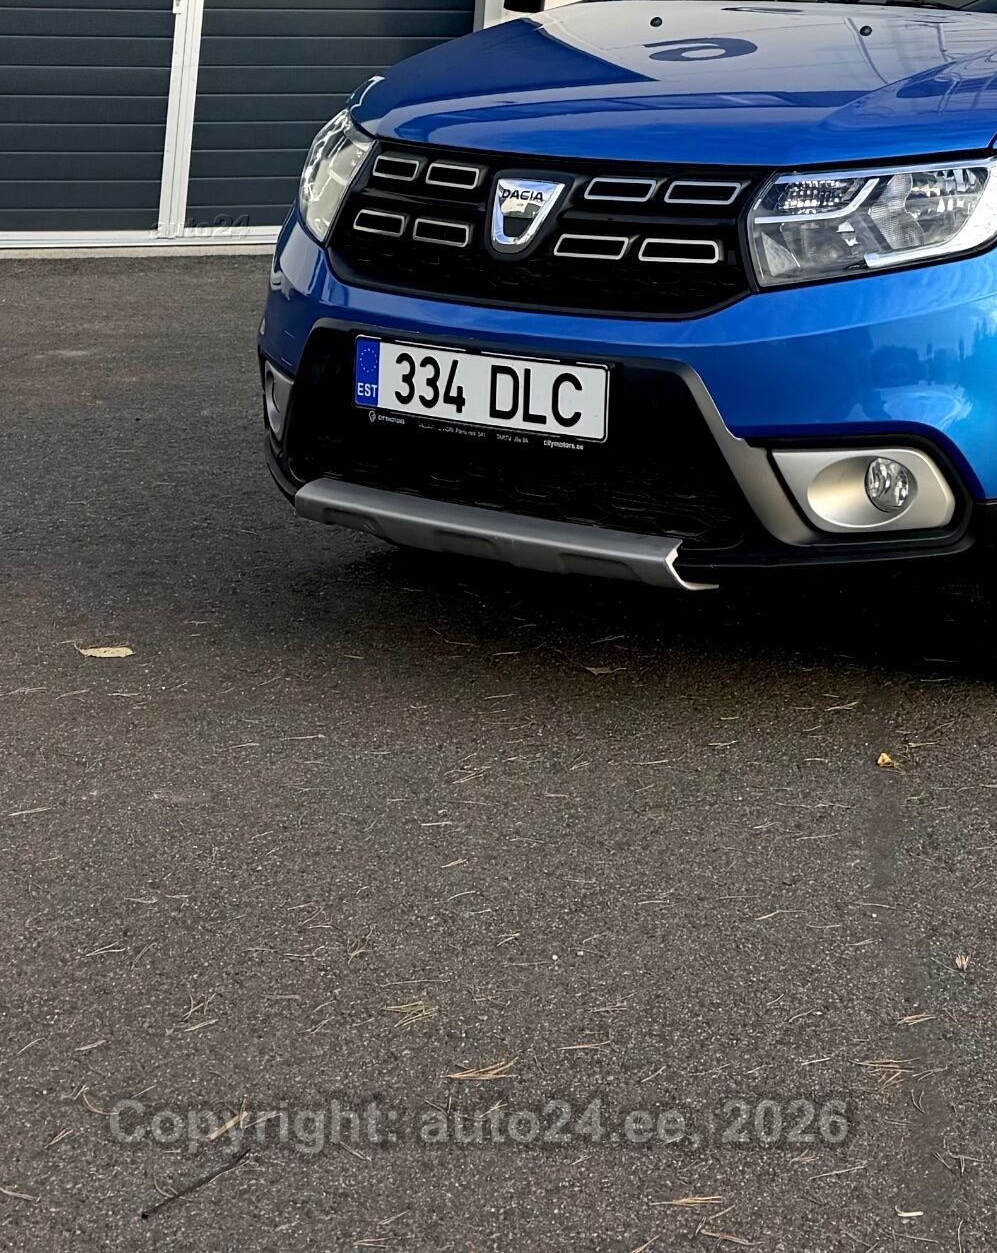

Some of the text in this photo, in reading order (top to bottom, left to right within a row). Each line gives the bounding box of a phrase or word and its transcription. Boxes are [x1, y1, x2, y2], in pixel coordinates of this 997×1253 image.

[501, 187, 545, 202] DACIA
[356, 381, 379, 398] EST
[394, 352, 584, 428] 334 DLC
